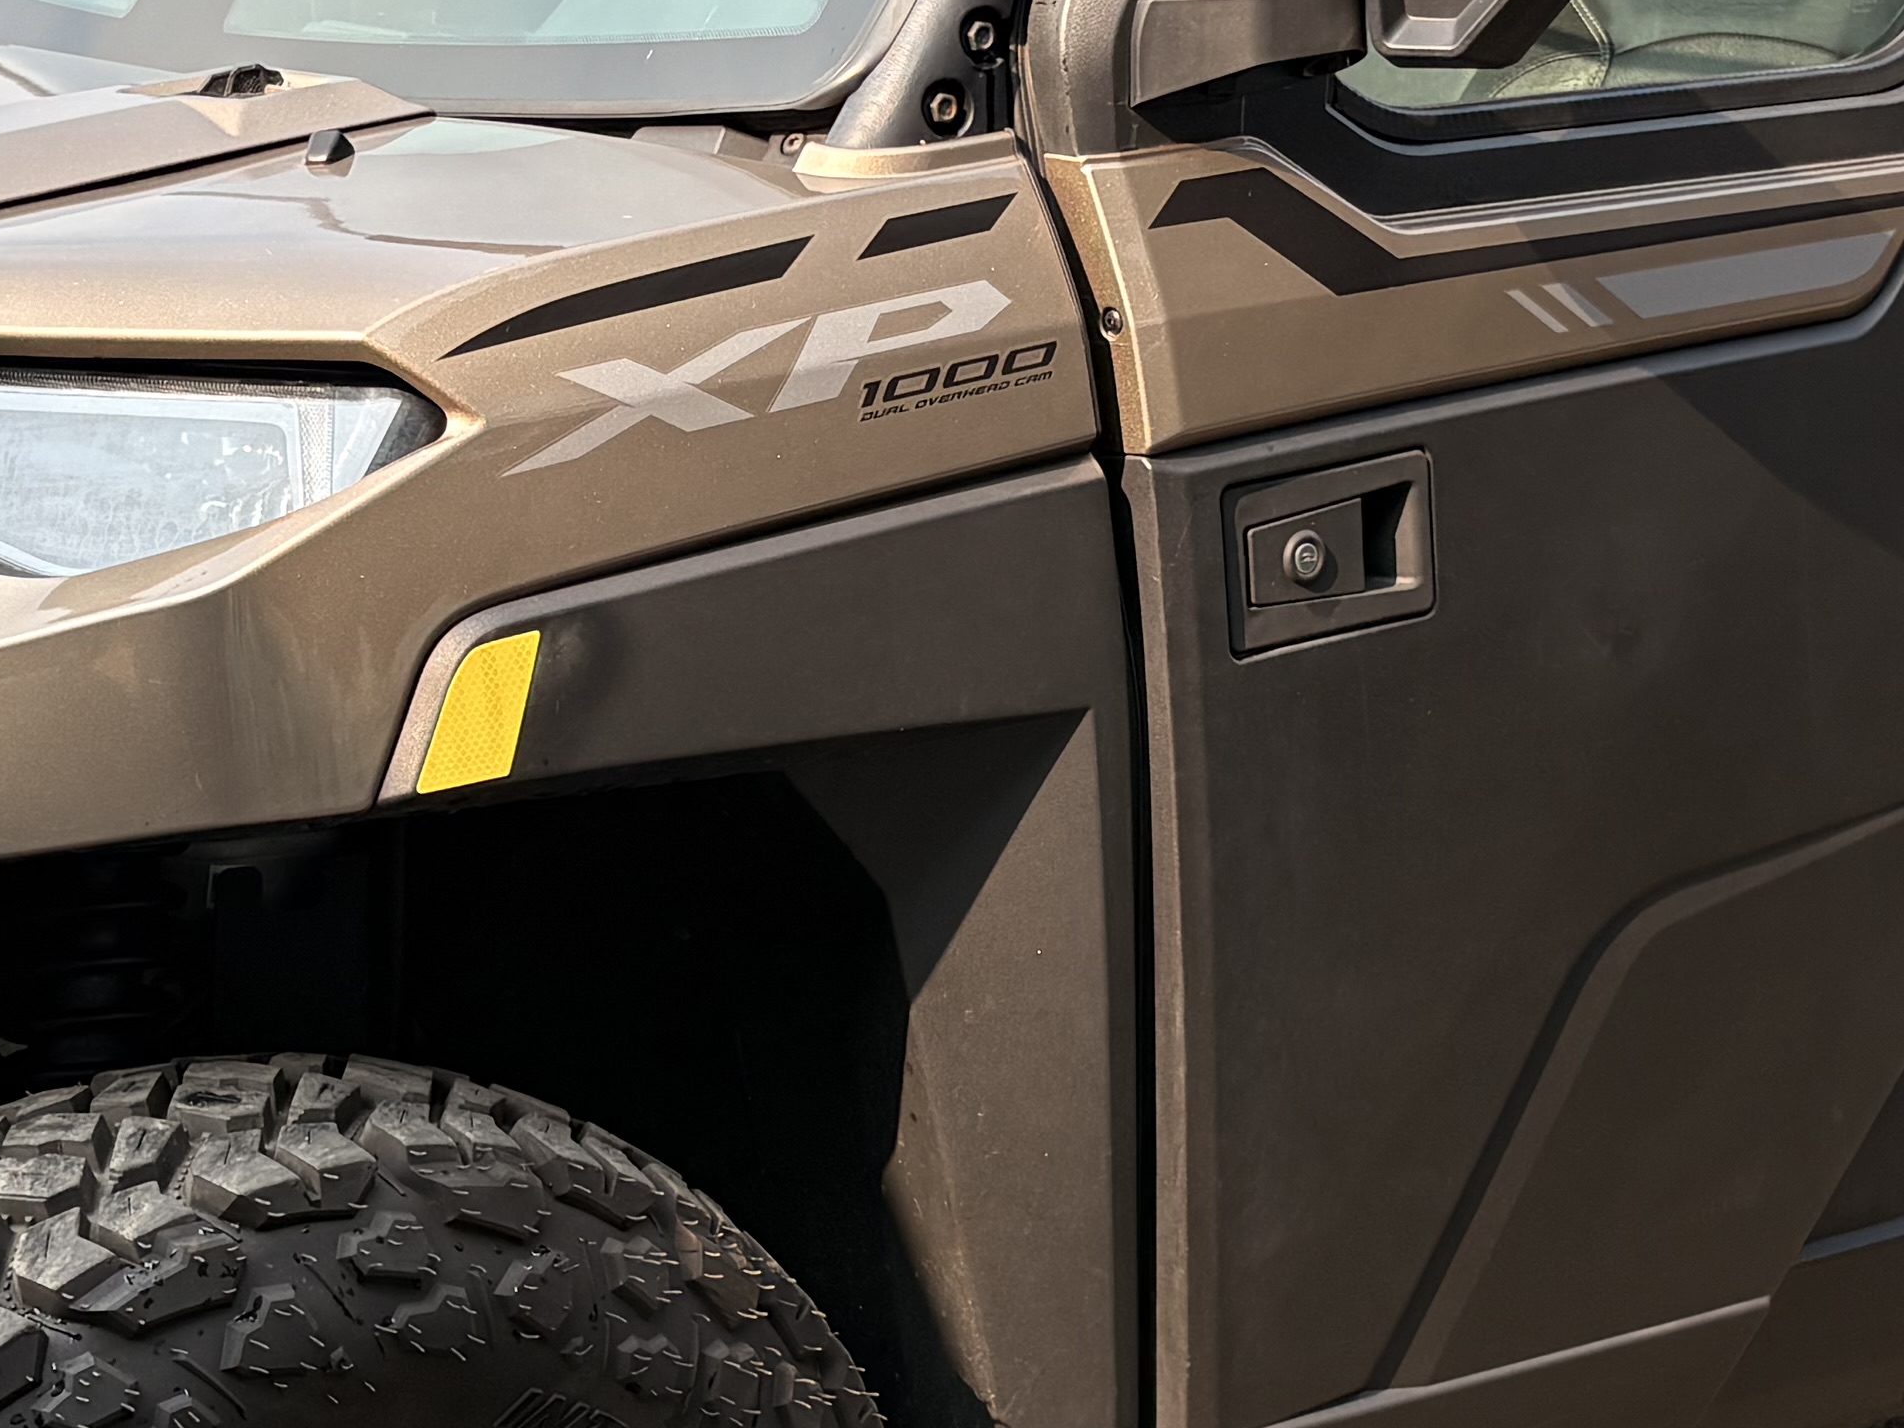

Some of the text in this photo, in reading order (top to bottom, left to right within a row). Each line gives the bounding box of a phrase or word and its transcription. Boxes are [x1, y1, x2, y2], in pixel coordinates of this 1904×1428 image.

[499, 279, 1012, 477] XP
[859, 370, 1054, 423] DUAL OVERHEAD CAM
[860, 340, 1058, 409] 1000
